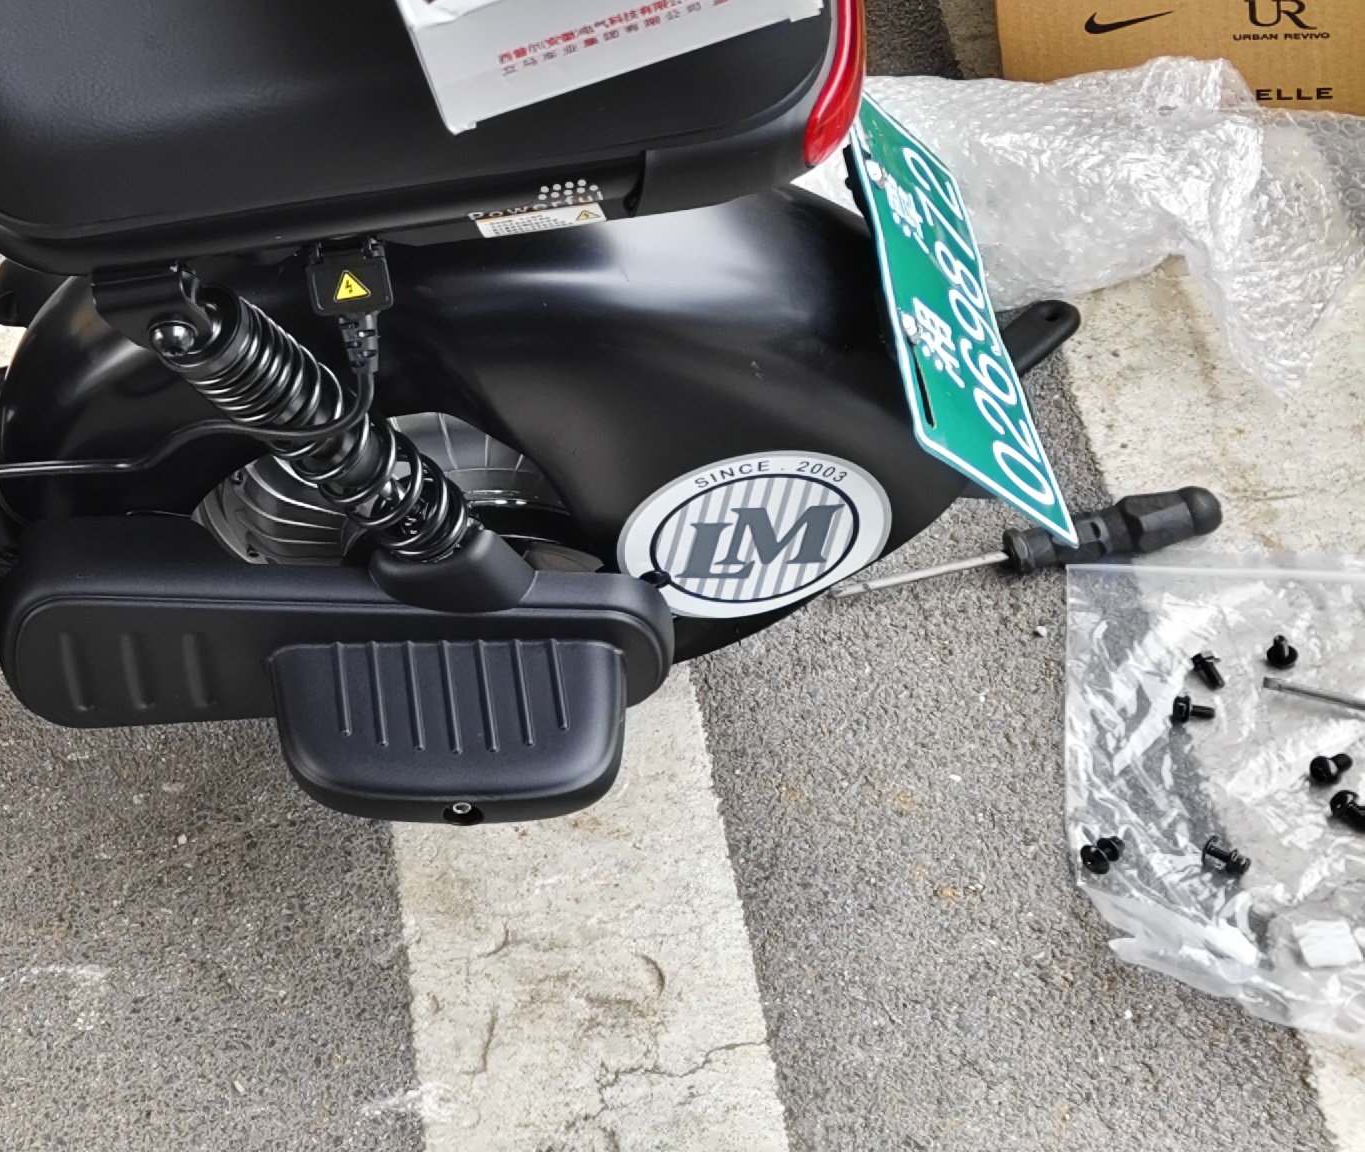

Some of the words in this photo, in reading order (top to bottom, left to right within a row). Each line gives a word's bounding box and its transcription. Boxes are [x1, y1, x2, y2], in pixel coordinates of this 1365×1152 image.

[1233, 33, 1279, 41] URBAN
[1283, 32, 1330, 40] REVIVO
[1255, 87, 1334, 101] ELLE
[467, 190, 606, 222] Powerful
[903, 147, 1055, 506] 0269872
[694, 460, 770, 488] SINCE
[796, 460, 848, 483] 2003
[674, 503, 845, 579] LM
